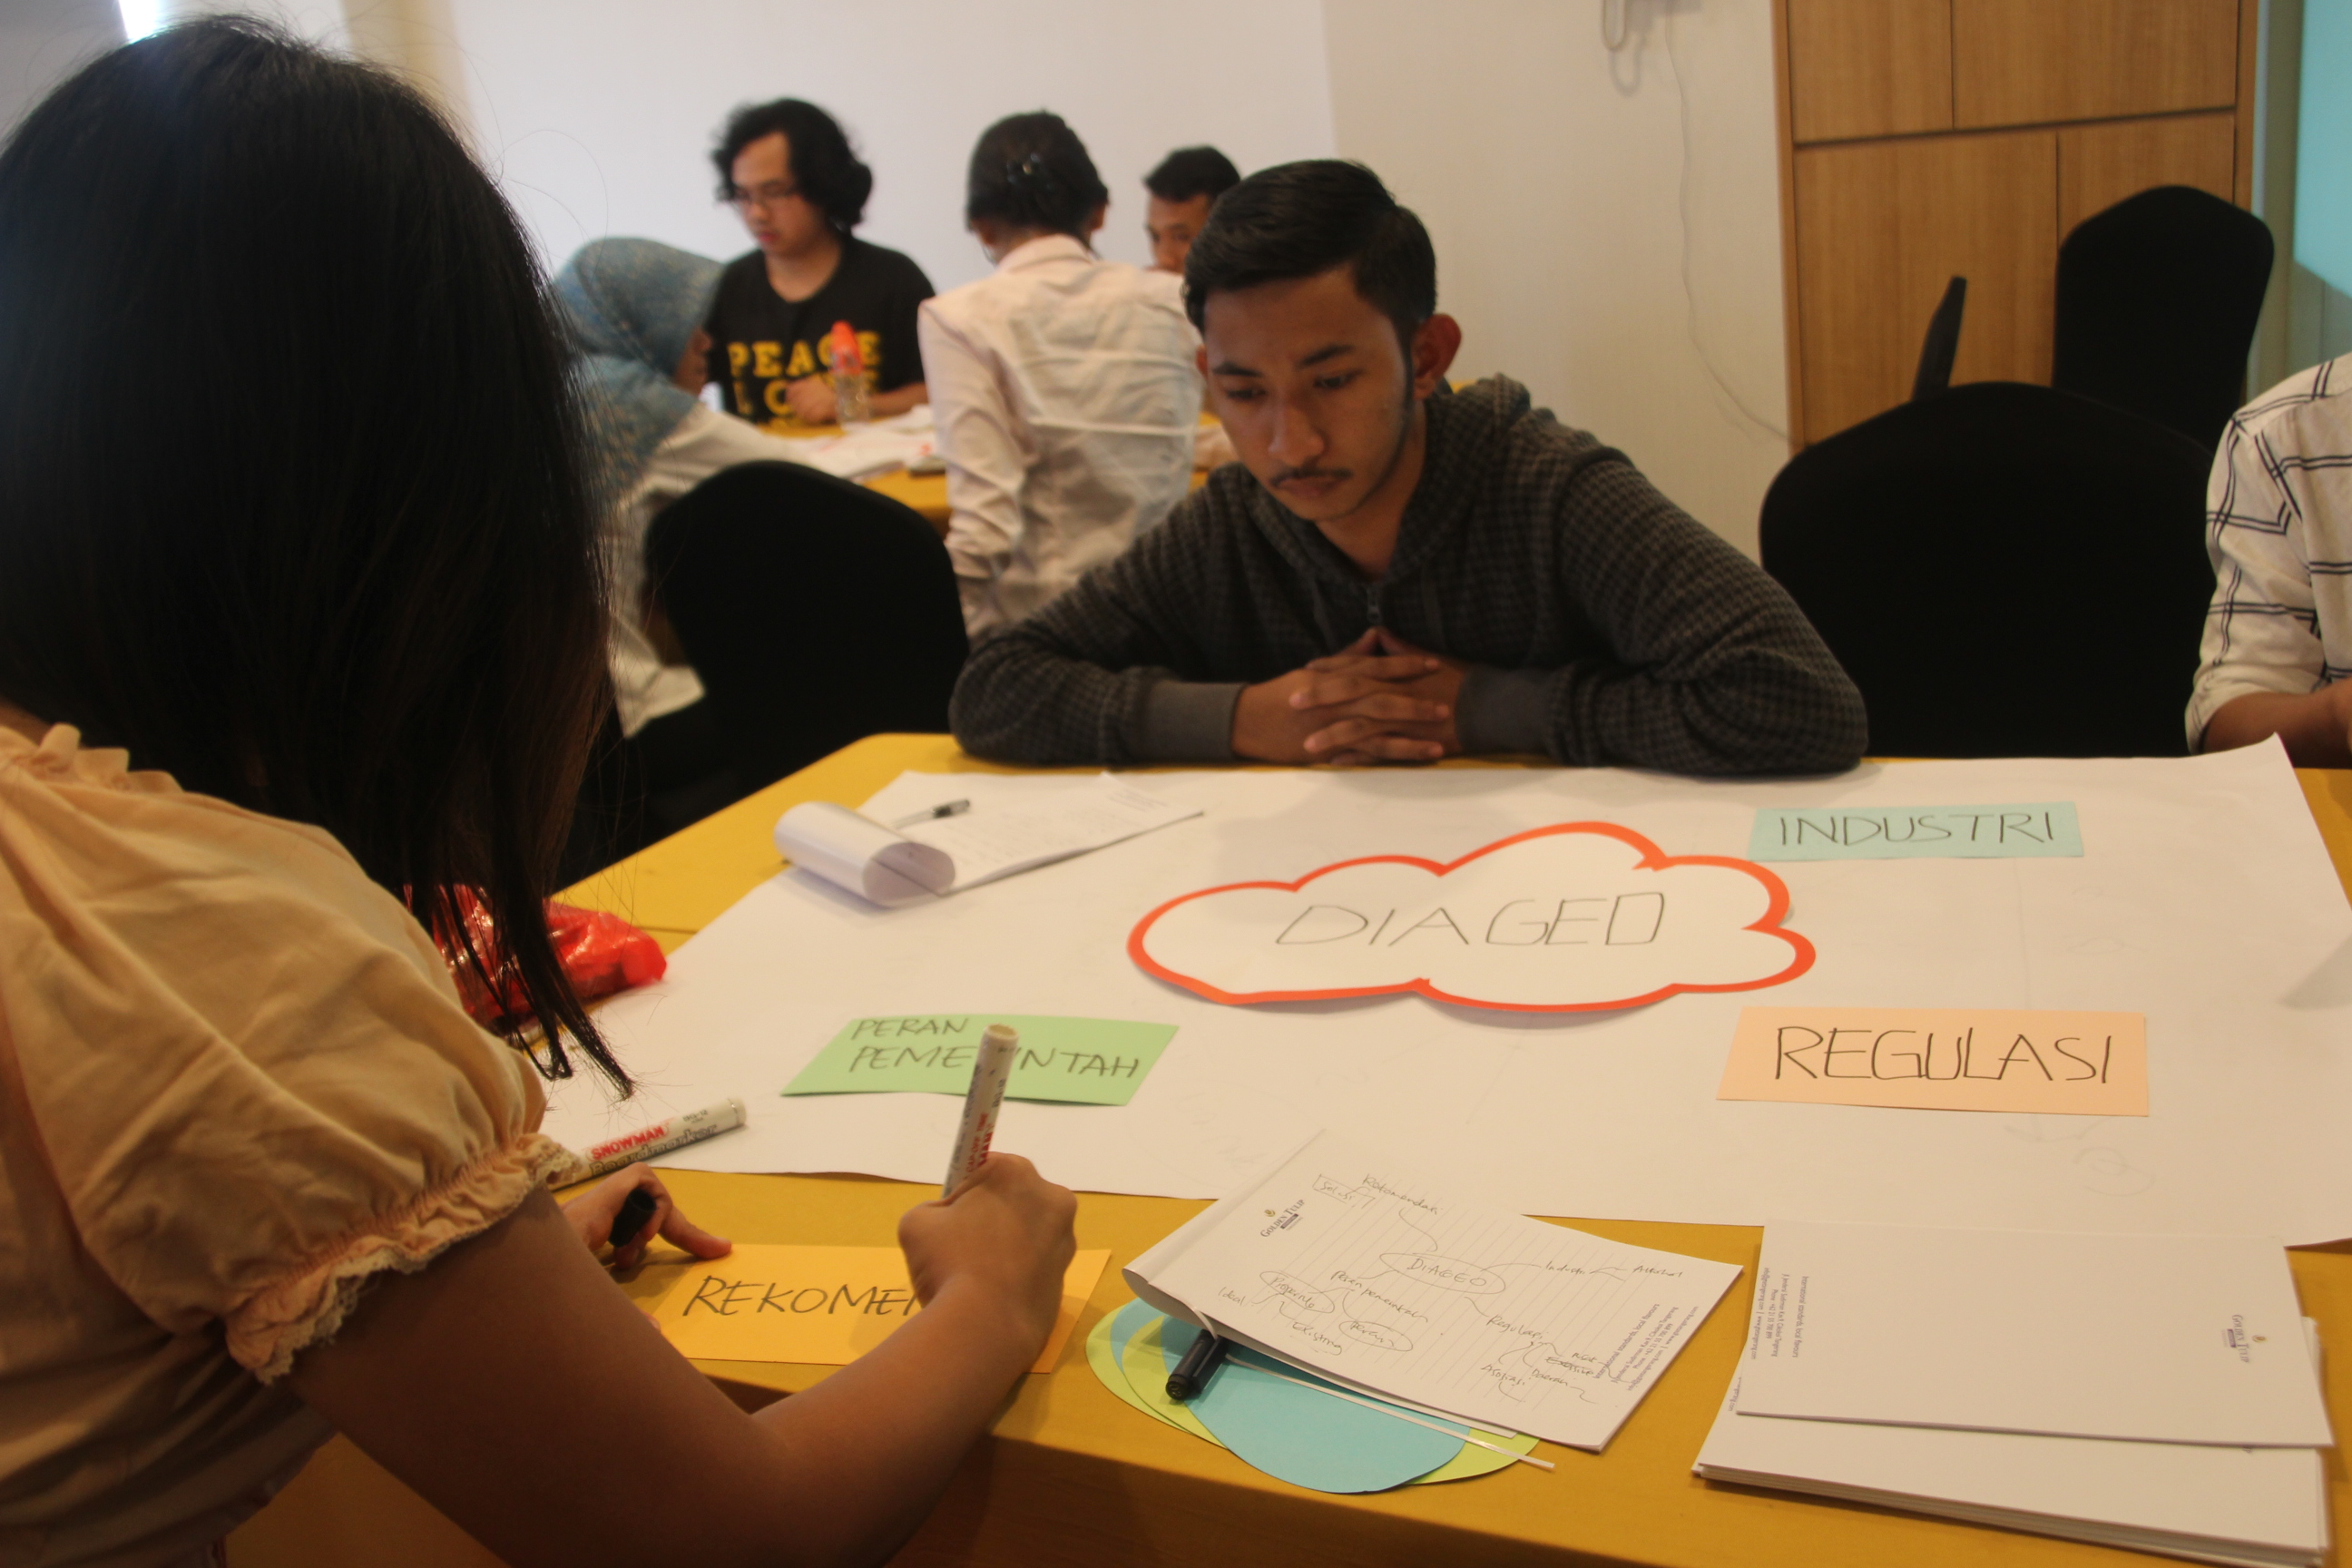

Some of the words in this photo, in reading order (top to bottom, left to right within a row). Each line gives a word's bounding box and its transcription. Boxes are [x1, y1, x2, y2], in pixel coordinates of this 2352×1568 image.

[1779, 811, 2054, 847] INDUSTRI
[850, 1017, 969, 1041] PERAN
[848, 1044, 1141, 1080] PEMENTAH
[1774, 1024, 2112, 1084] REGULASI
[590, 1125, 665, 1161] SNOWMAN
[1259, 1214, 1288, 1238] GOLDEN
[1283, 1199, 1305, 1215] TULIP
